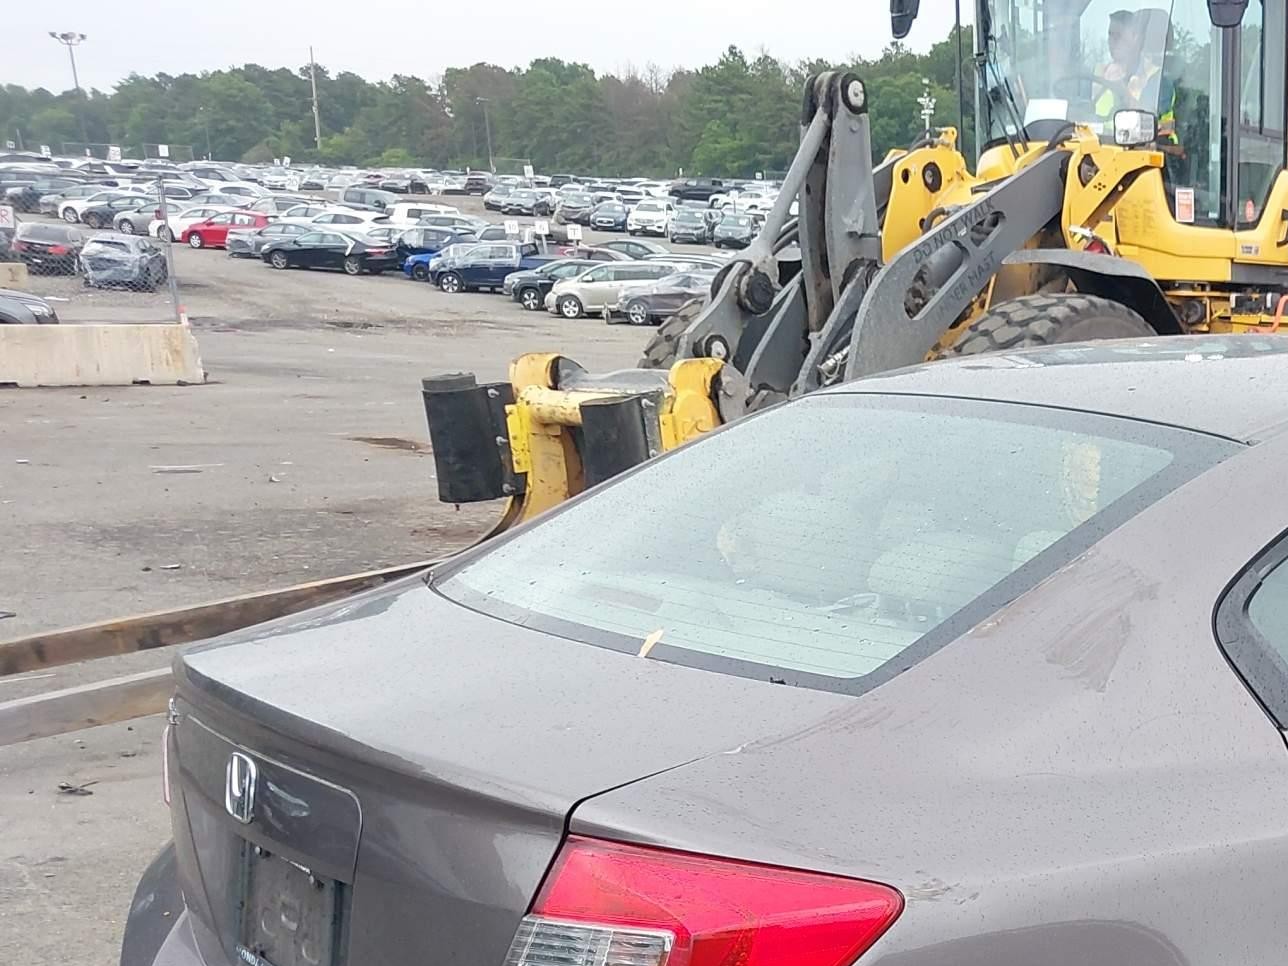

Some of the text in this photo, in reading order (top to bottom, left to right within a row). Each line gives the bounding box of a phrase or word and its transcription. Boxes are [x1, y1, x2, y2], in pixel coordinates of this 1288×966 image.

[913, 197, 996, 264] DO NOT WALK
[969, 250, 996, 287] MAST
